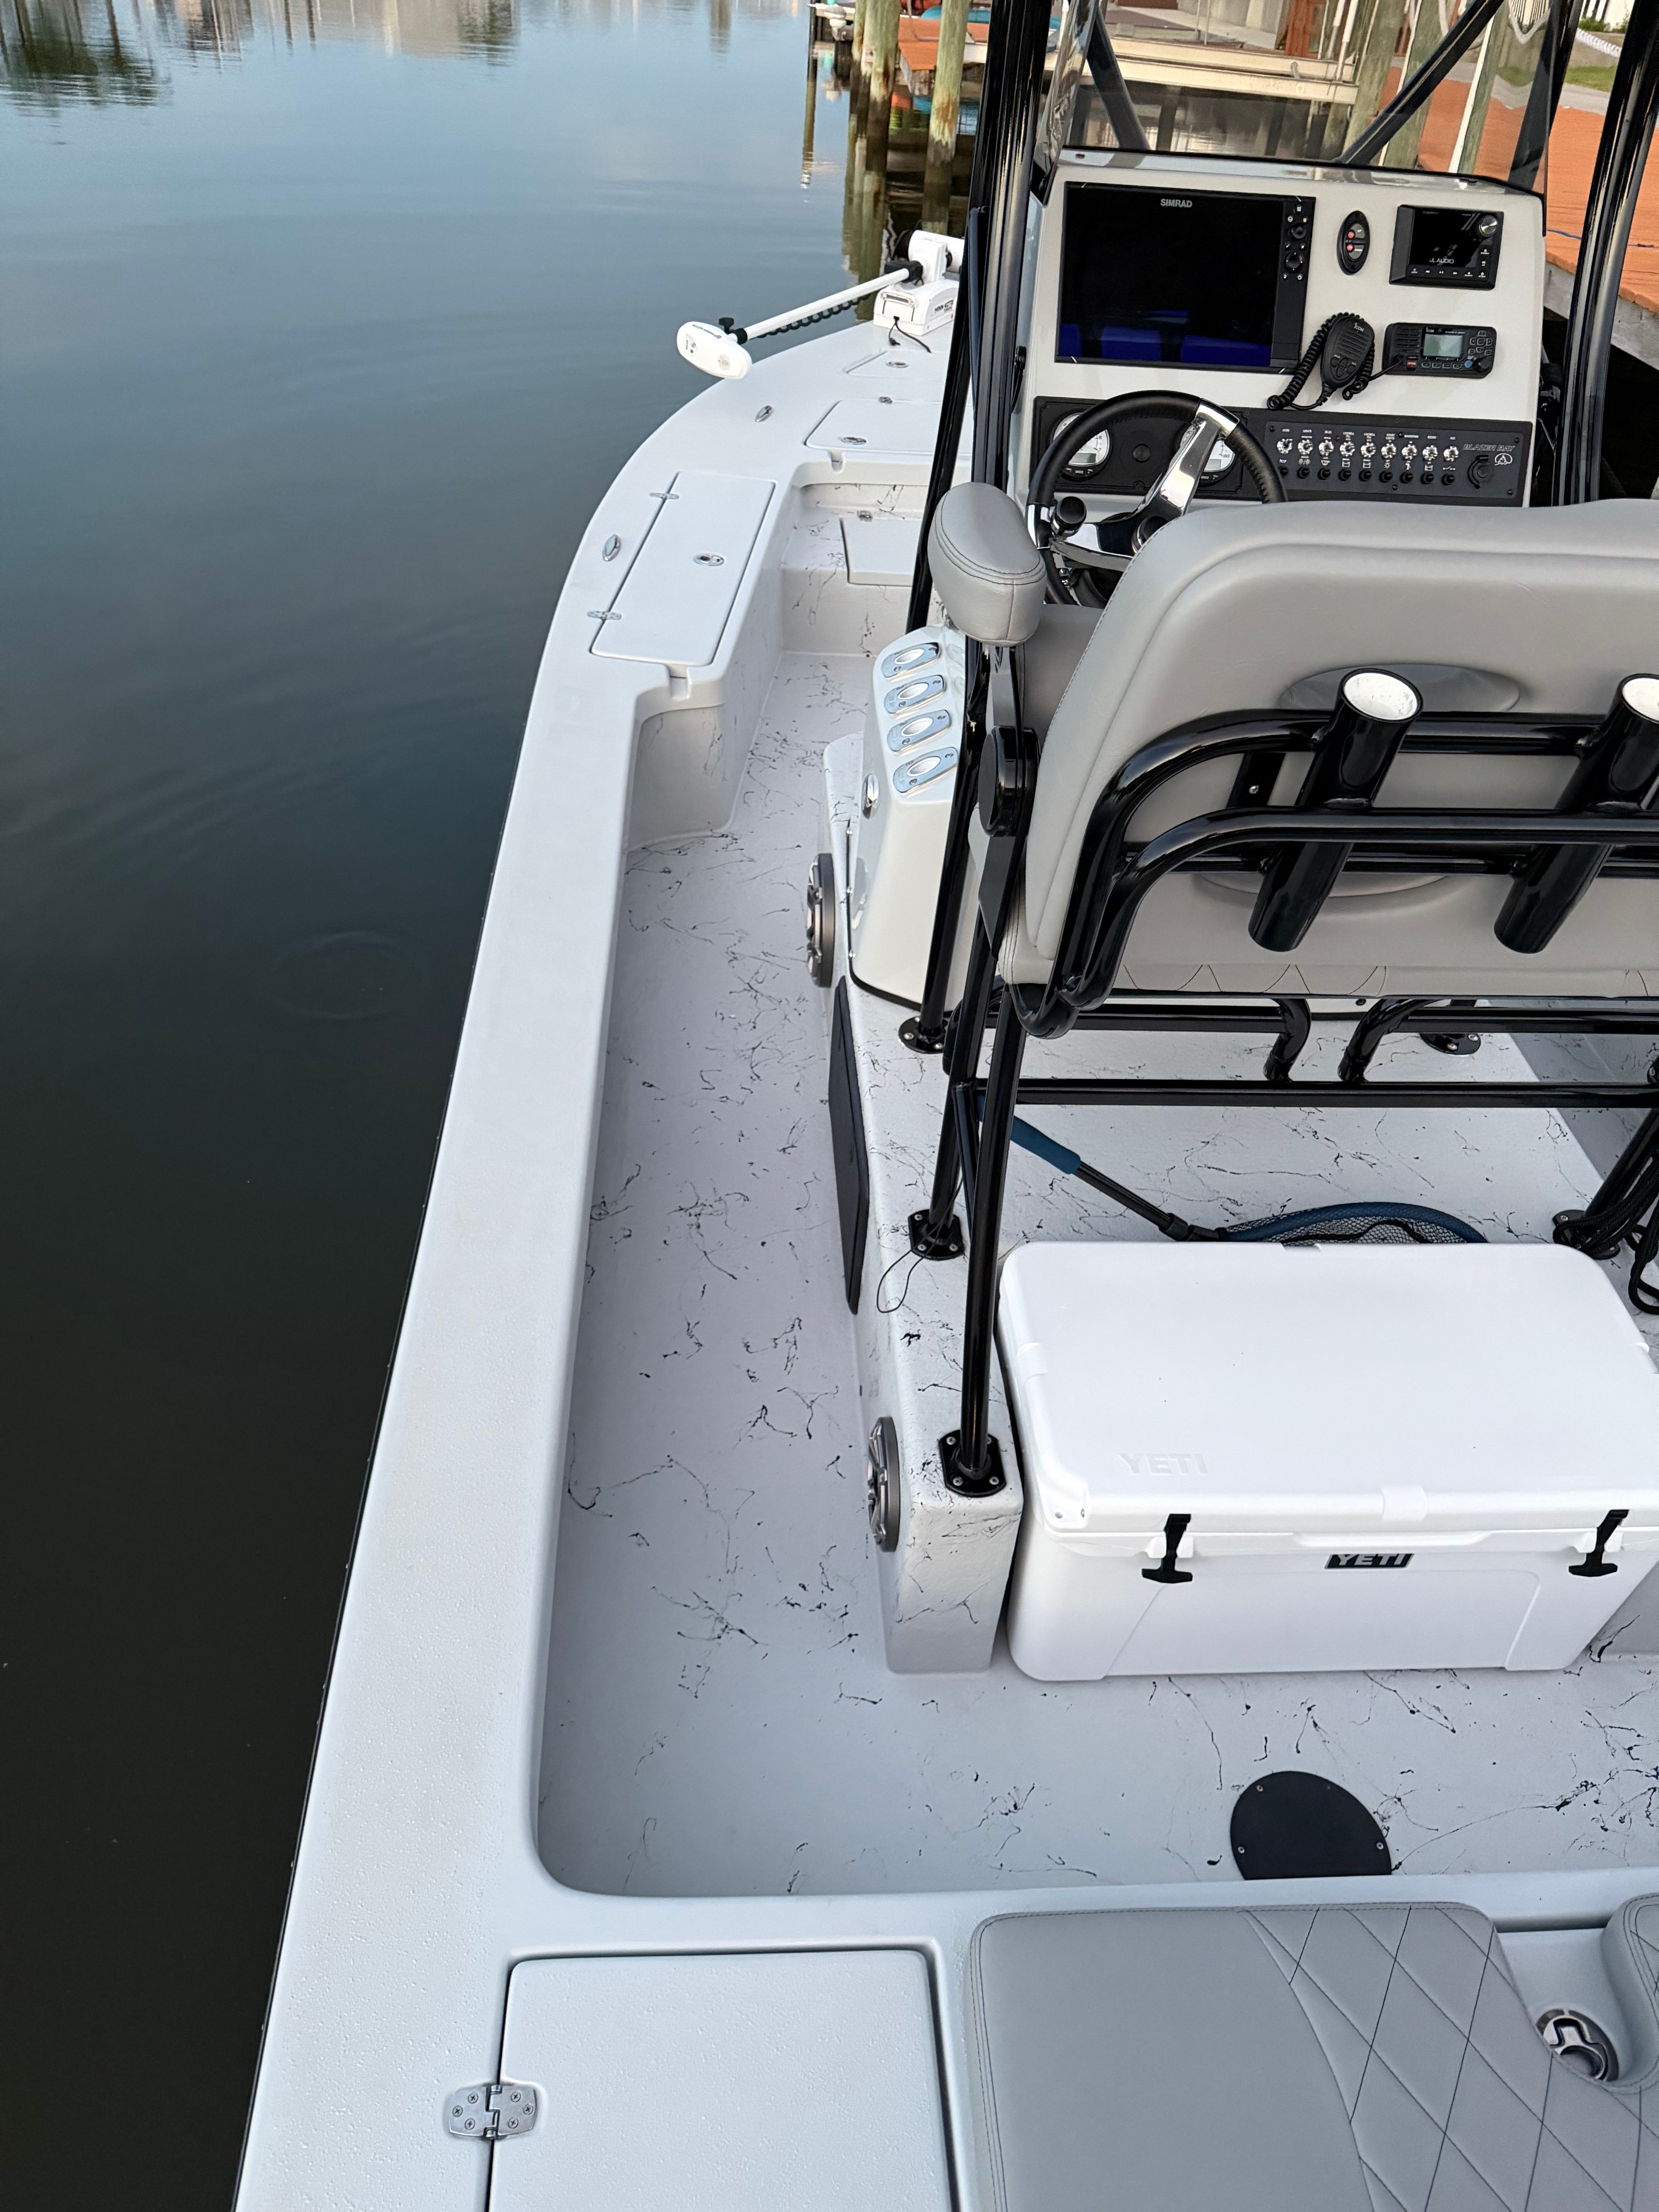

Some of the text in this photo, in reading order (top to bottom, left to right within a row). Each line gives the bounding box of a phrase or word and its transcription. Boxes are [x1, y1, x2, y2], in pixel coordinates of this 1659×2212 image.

[1160, 198, 1193, 208] SIMRAD
[1118, 1453, 1207, 1475] YETI
[1338, 1554, 1406, 1565] YETI
